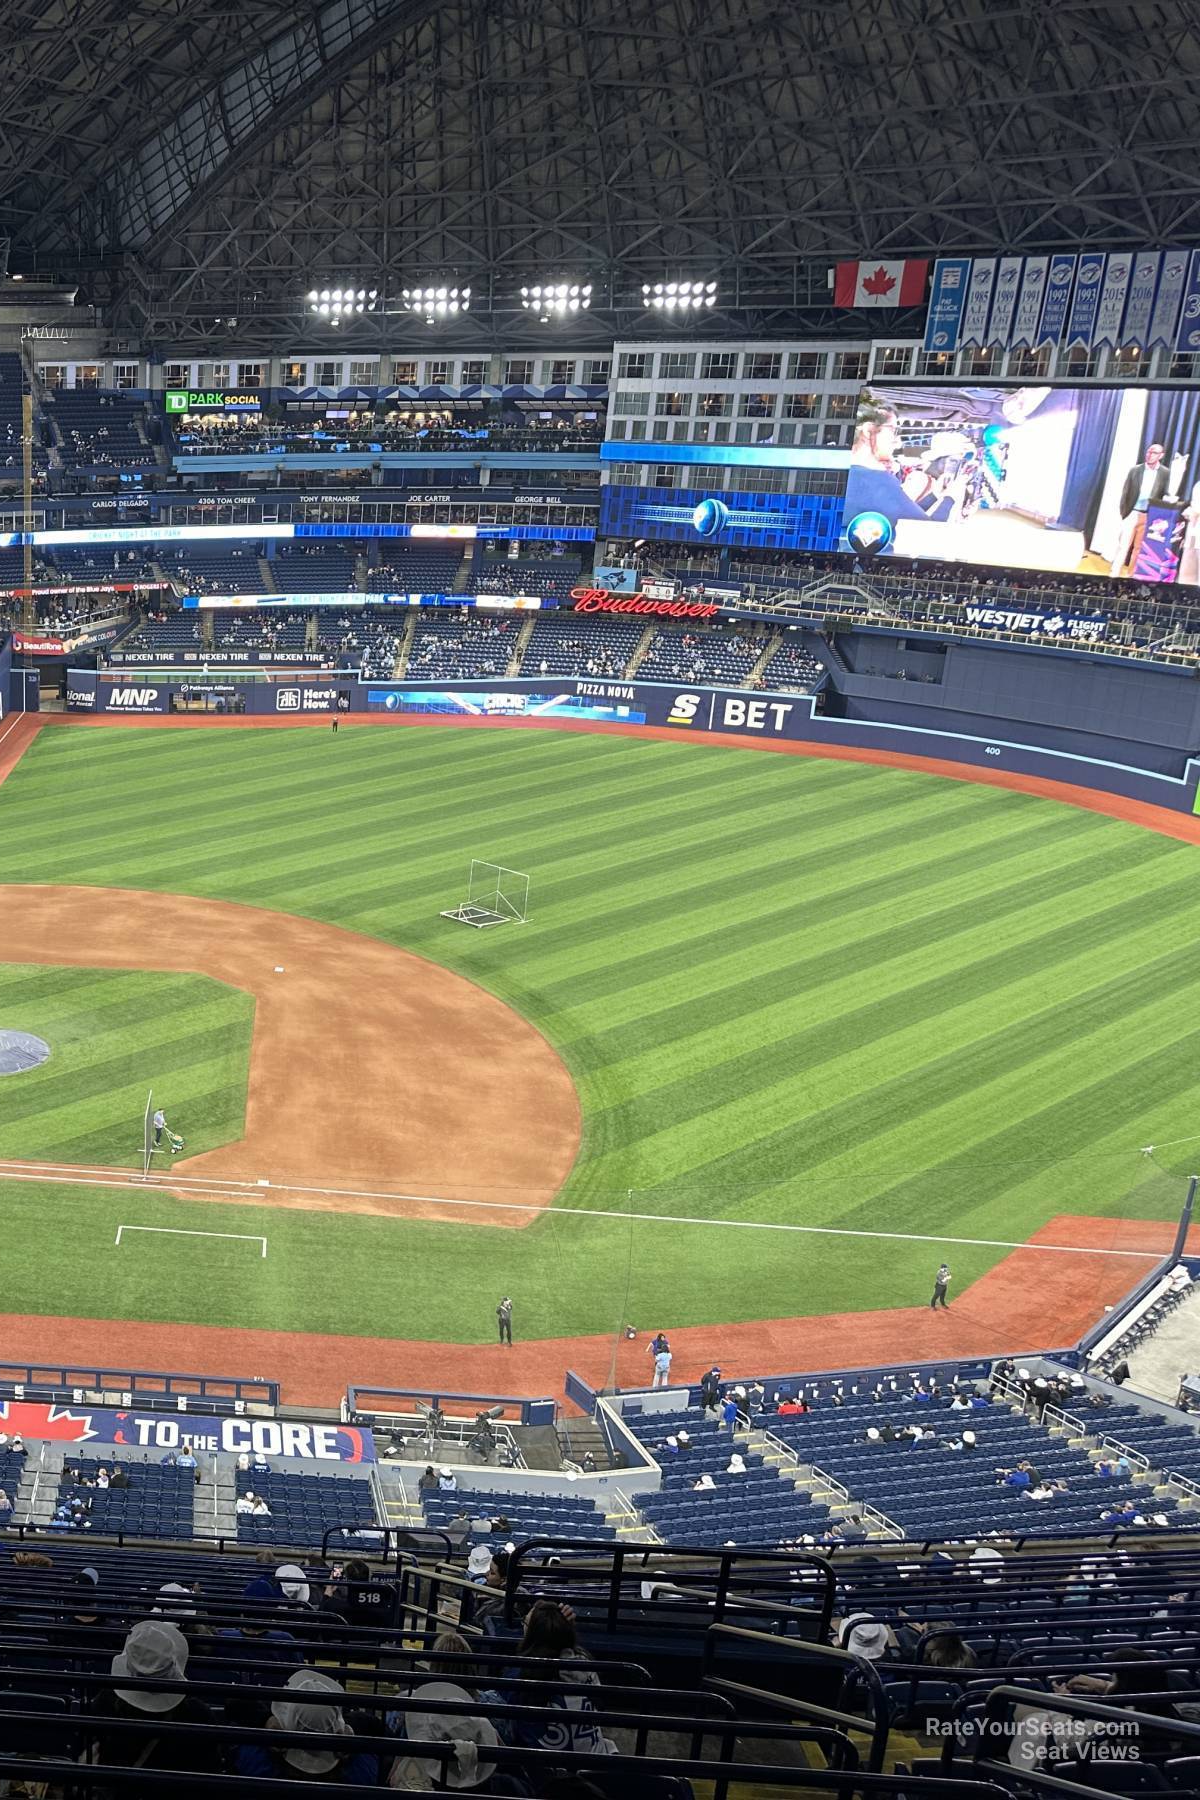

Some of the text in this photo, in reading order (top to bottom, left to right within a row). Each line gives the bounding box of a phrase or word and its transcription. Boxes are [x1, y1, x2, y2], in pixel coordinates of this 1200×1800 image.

[1049, 289, 1067, 302] 1992
[1078, 288, 1096, 302] 1993
[168, 393, 260, 409] TD PARK SOCIAL
[198, 497, 215, 505] 4306
[300, 495, 360, 503] TONY FERNANDEZ
[32, 588, 50, 596] Proud
[100, 585, 115, 594] Jays
[571, 588, 719, 618] Budweiser
[966, 607, 1045, 630] WESTJET
[1067, 619, 1106, 631] FLIGHT
[125, 653, 152, 661] NEXEN
[199, 653, 228, 661] NEXEN
[274, 653, 303, 661] NEXEN
[304, 688, 337, 699] Here's
[576, 682, 635, 699] PIZZA NOVA
[109, 688, 158, 706] MNP
[303, 699, 330, 709] How.
[723, 698, 793, 731] BET
[984, 746, 1000, 755] 400
[135, 1418, 341, 1461] TO THE CORE
[358, 1592, 381, 1604] 518
